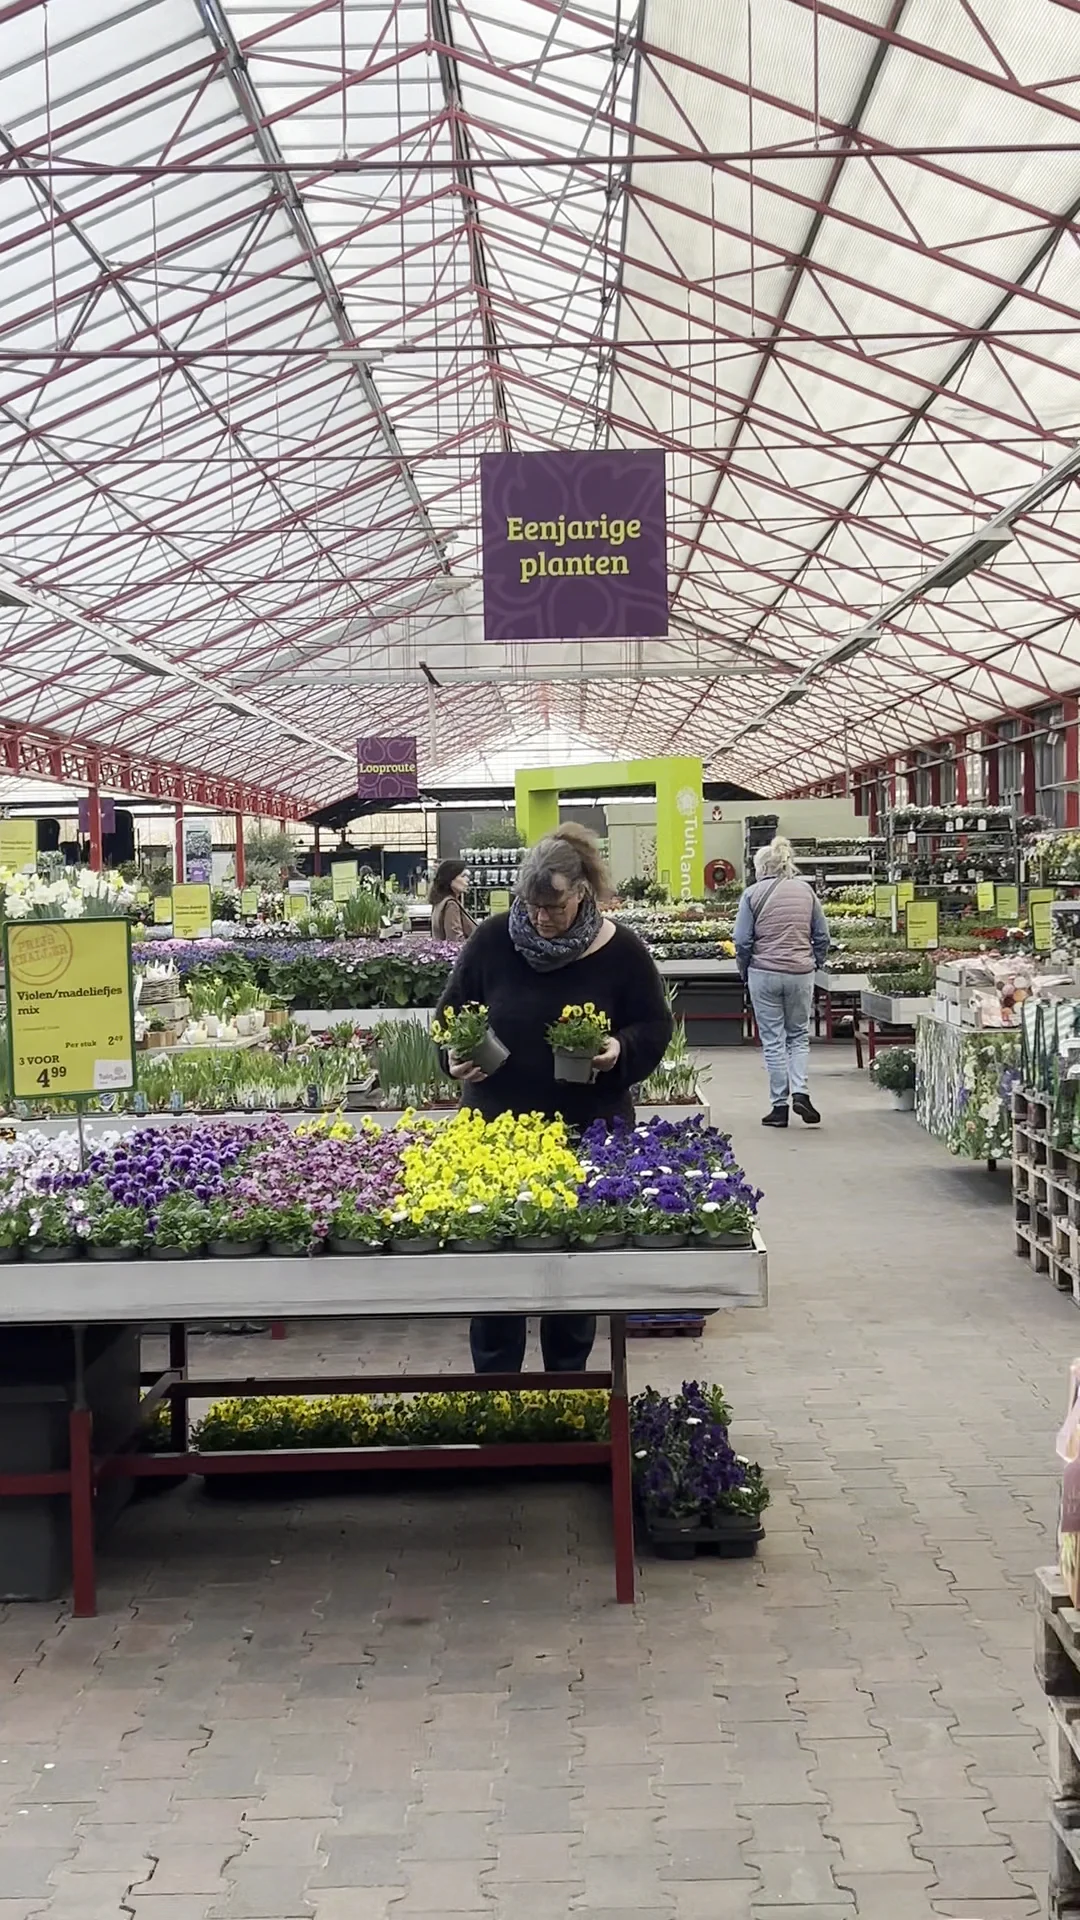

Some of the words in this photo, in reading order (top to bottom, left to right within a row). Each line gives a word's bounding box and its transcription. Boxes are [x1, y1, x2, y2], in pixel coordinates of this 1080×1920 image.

[507, 513, 641, 546] Eenjarige
[519, 551, 630, 583] planten
[359, 763, 416, 775] Looproute
[17, 986, 123, 1000] Violen/madeliefjes
[17, 1005, 40, 1015] mix
[65, 1041, 79, 1049] Per
[80, 1040, 97, 1048] stuk
[19, 1057, 25, 1066] 3
[27, 1055, 60, 1065] VOOR
